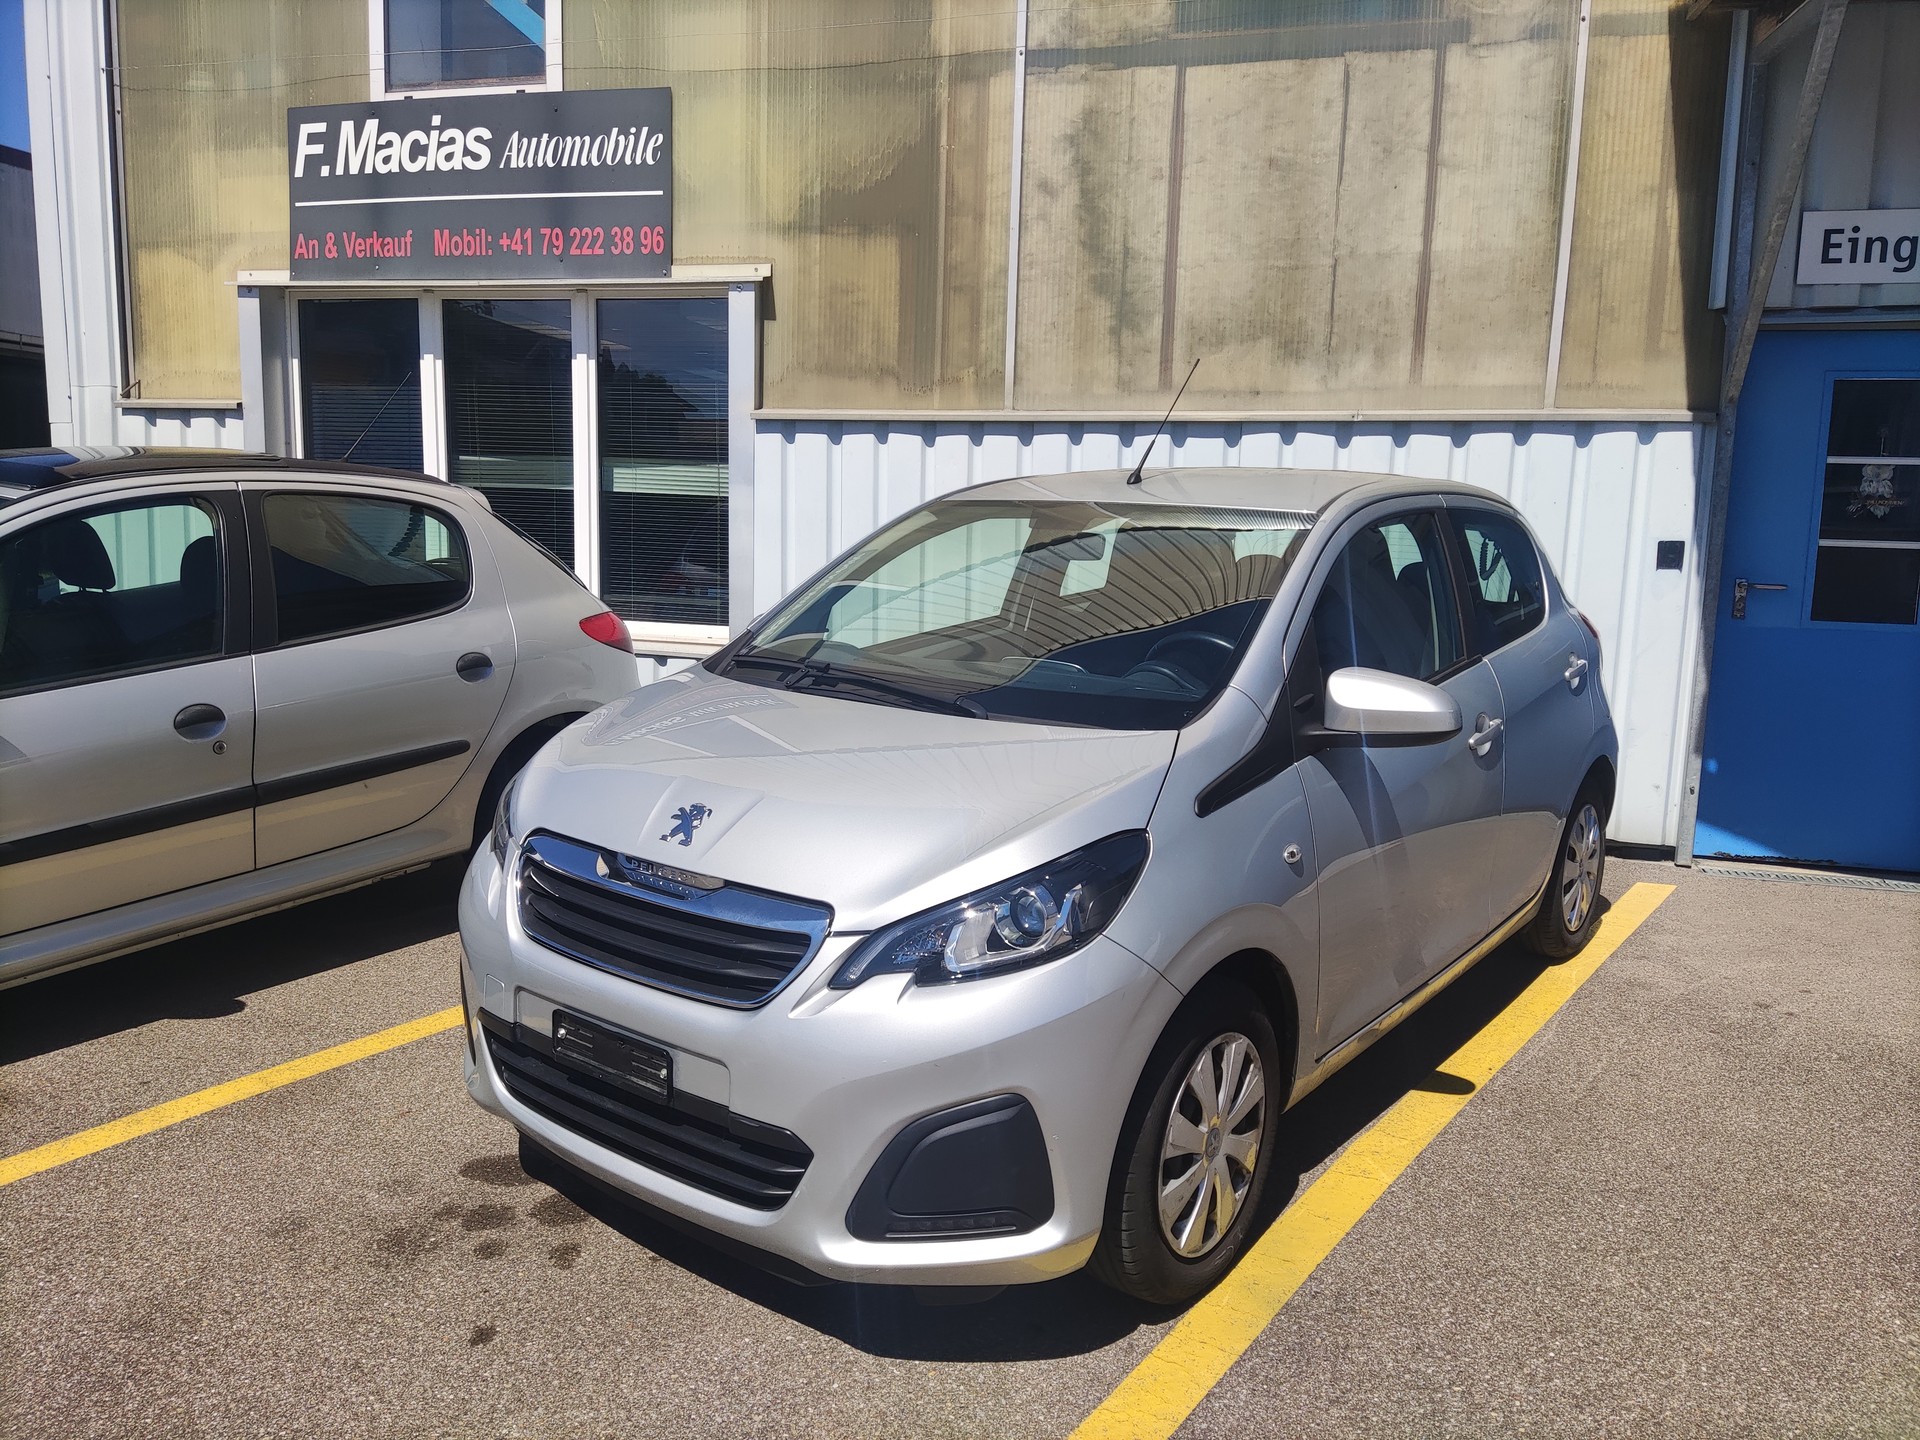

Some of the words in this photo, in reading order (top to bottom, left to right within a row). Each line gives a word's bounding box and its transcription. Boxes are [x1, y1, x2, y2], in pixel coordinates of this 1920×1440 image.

[294, 115, 492, 178] F.Macias
[499, 126, 664, 168] Automobile
[294, 233, 319, 259] An
[324, 231, 338, 259] &
[342, 229, 413, 258] Verkauf
[434, 228, 493, 256] Mobil:
[499, 228, 532, 256] +41
[540, 227, 564, 256] 79
[569, 227, 605, 255] 222
[610, 226, 634, 255] 38
[640, 225, 665, 255] 96
[1821, 225, 1919, 273] Eing
